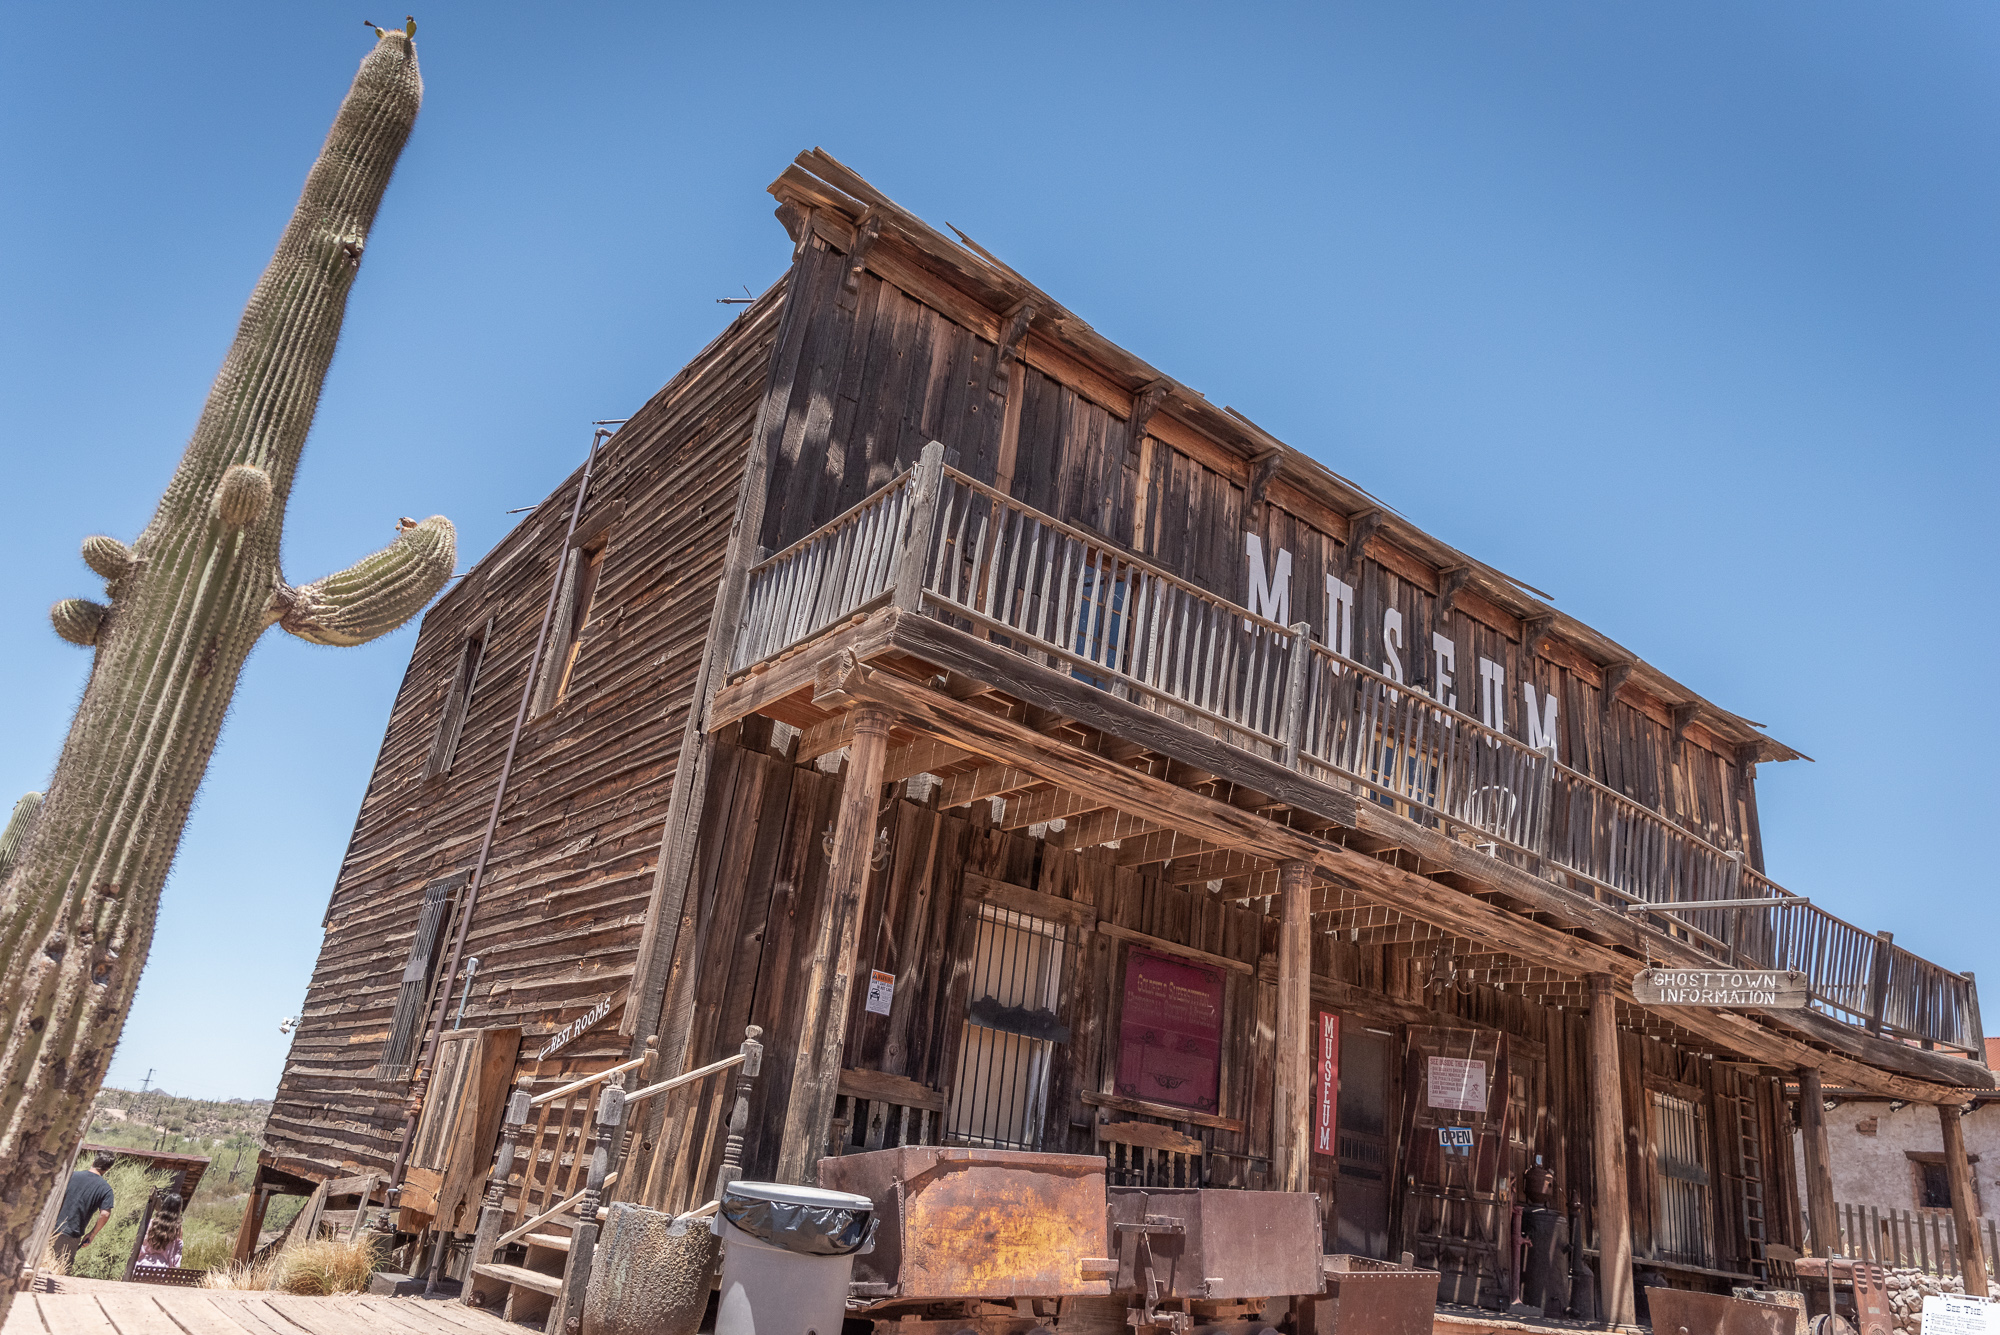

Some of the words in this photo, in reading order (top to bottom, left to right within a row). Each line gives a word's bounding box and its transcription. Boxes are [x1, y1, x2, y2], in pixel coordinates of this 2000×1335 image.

[1246, 531, 1558, 772] MUSEUM
[1654, 972, 1710, 987] GHOST
[1716, 973, 1776, 989] TOWN
[1661, 988, 1776, 1005] INFORMATION
[550, 1025, 573, 1053] REST
[573, 996, 611, 1037] ROOMS
[1320, 1015, 1334, 1150] MUSEUM
[1442, 1131, 1471, 1144] OPEN
